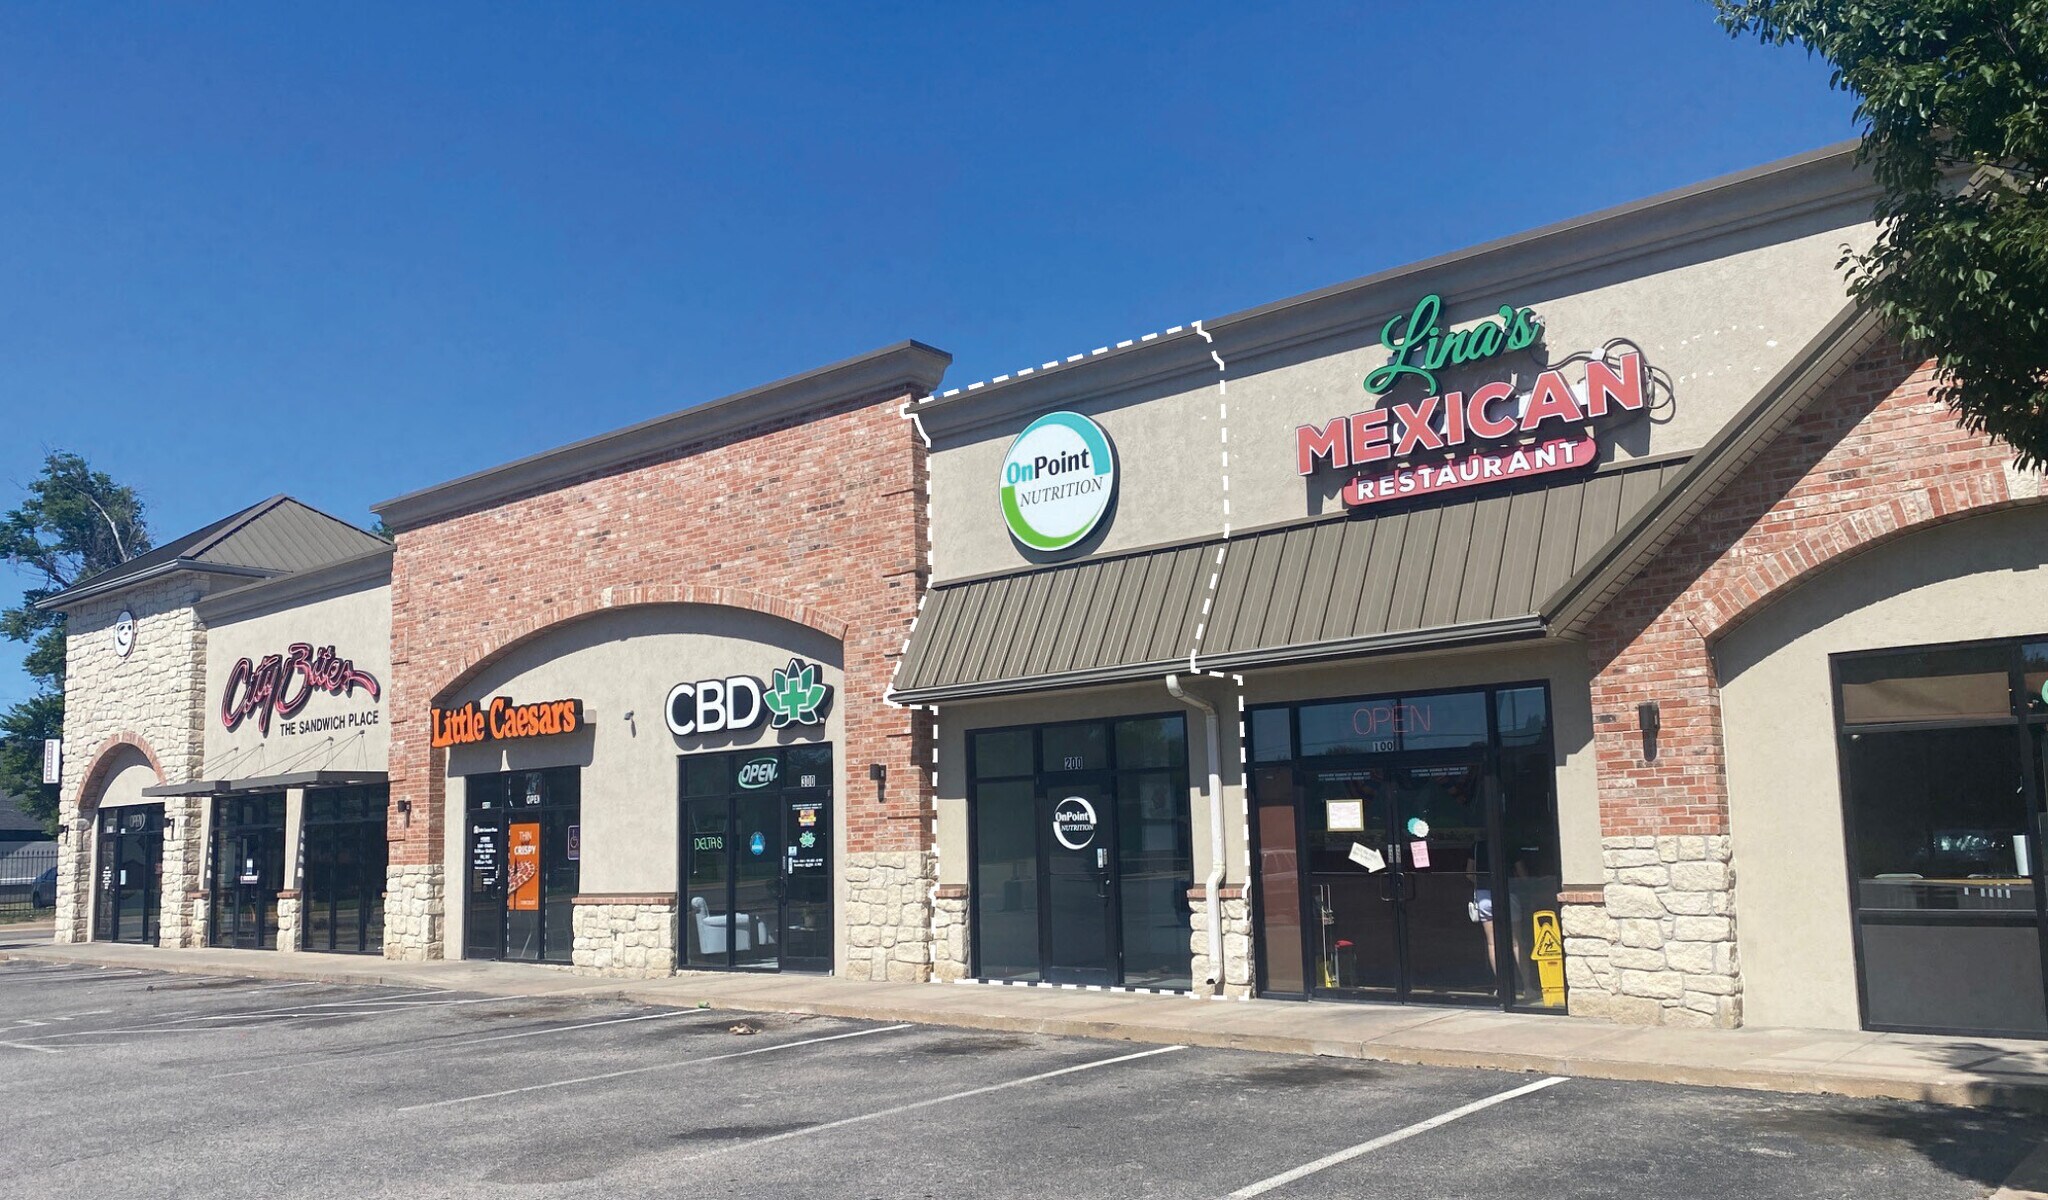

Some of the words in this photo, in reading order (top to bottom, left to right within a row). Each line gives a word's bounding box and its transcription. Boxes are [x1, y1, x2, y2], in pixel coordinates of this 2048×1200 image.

[1363, 294, 1540, 396] Lina's
[1295, 352, 1645, 476] MEXICAN
[1006, 448, 1090, 485] OnPoint
[1357, 440, 1579, 501] RESTAURANT
[1020, 477, 1103, 507] NUTRITION
[221, 654, 283, 732] City
[275, 642, 380, 713] Bites
[665, 675, 761, 735] CBD
[1353, 704, 1431, 735] OPEN
[280, 722, 296, 736] THE
[299, 716, 345, 734] SANDWICH
[349, 710, 379, 727] PLACE
[431, 701, 485, 747] Little
[489, 697, 576, 740] Caesars
[1373, 741, 1394, 751] 100
[741, 764, 776, 782] OPEN
[1065, 757, 1083, 770] 200
[801, 775, 815, 787] 300
[1055, 811, 1089, 822] OnPoint
[1061, 824, 1094, 832] NUTRITION
[514, 845, 536, 856] CRISPY
